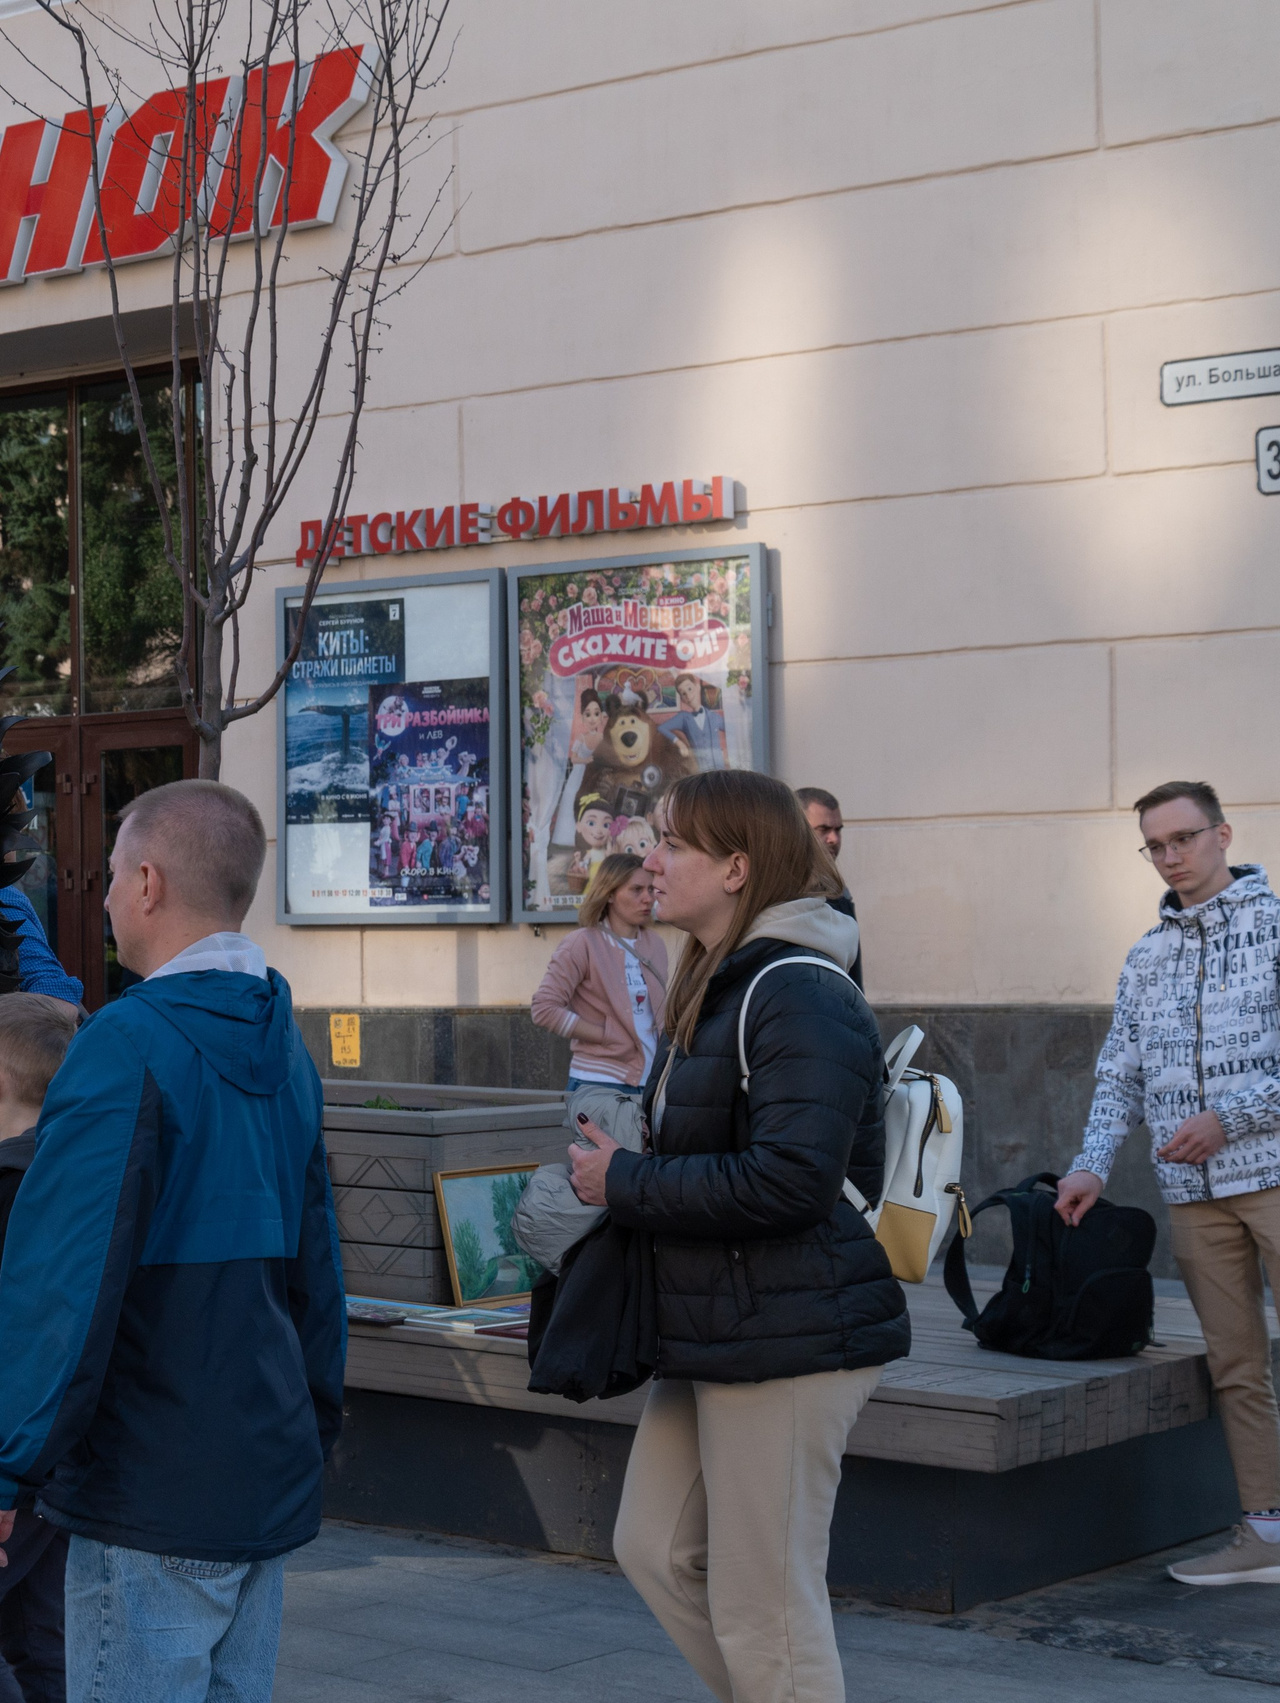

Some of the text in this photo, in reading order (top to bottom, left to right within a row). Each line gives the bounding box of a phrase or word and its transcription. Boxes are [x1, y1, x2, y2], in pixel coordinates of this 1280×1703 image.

[1176, 374, 1202, 392] ул.
[295, 476, 726, 567] ДЕТСКИЕ ФИЛЬМЫ
[568, 602, 614, 634] Маша
[623, 599, 704, 630] Медведь
[318, 629, 369, 656] КИТЫ:
[292, 655, 396, 679] СТРАЖИ ПЛАНЕТЫ
[405, 705, 490, 727] РАЗБОЙНИКА
[427, 729, 443, 739] ЛЕВ
[401, 867, 426, 876] СКОРО
